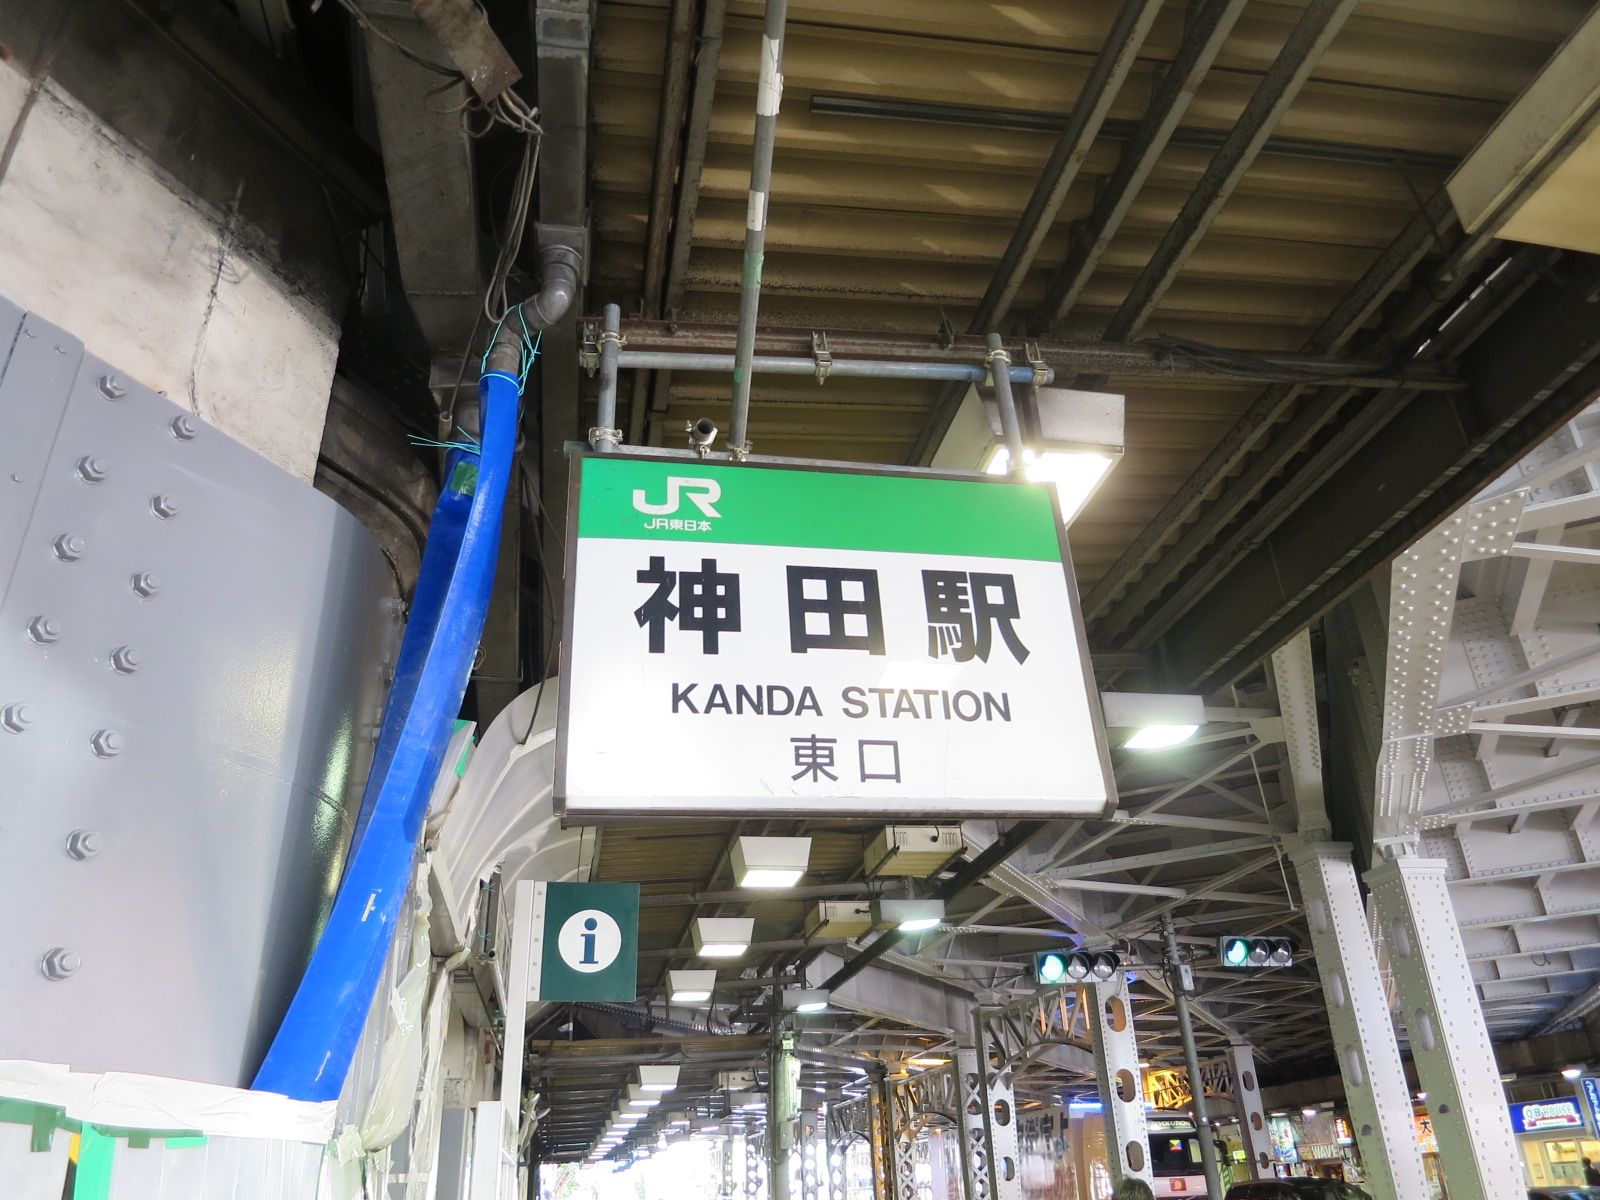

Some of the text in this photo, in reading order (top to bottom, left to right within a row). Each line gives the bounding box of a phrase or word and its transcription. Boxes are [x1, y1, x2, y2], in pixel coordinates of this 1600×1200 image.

[633, 476, 722, 518] JR
[643, 518, 712, 532] JR東日本
[633, 556, 1030, 665] 神田駅
[671, 682, 1012, 723] KANDA STATION
[790, 733, 902, 784] 東口
[1542, 1104, 1573, 1117] HOUSE
